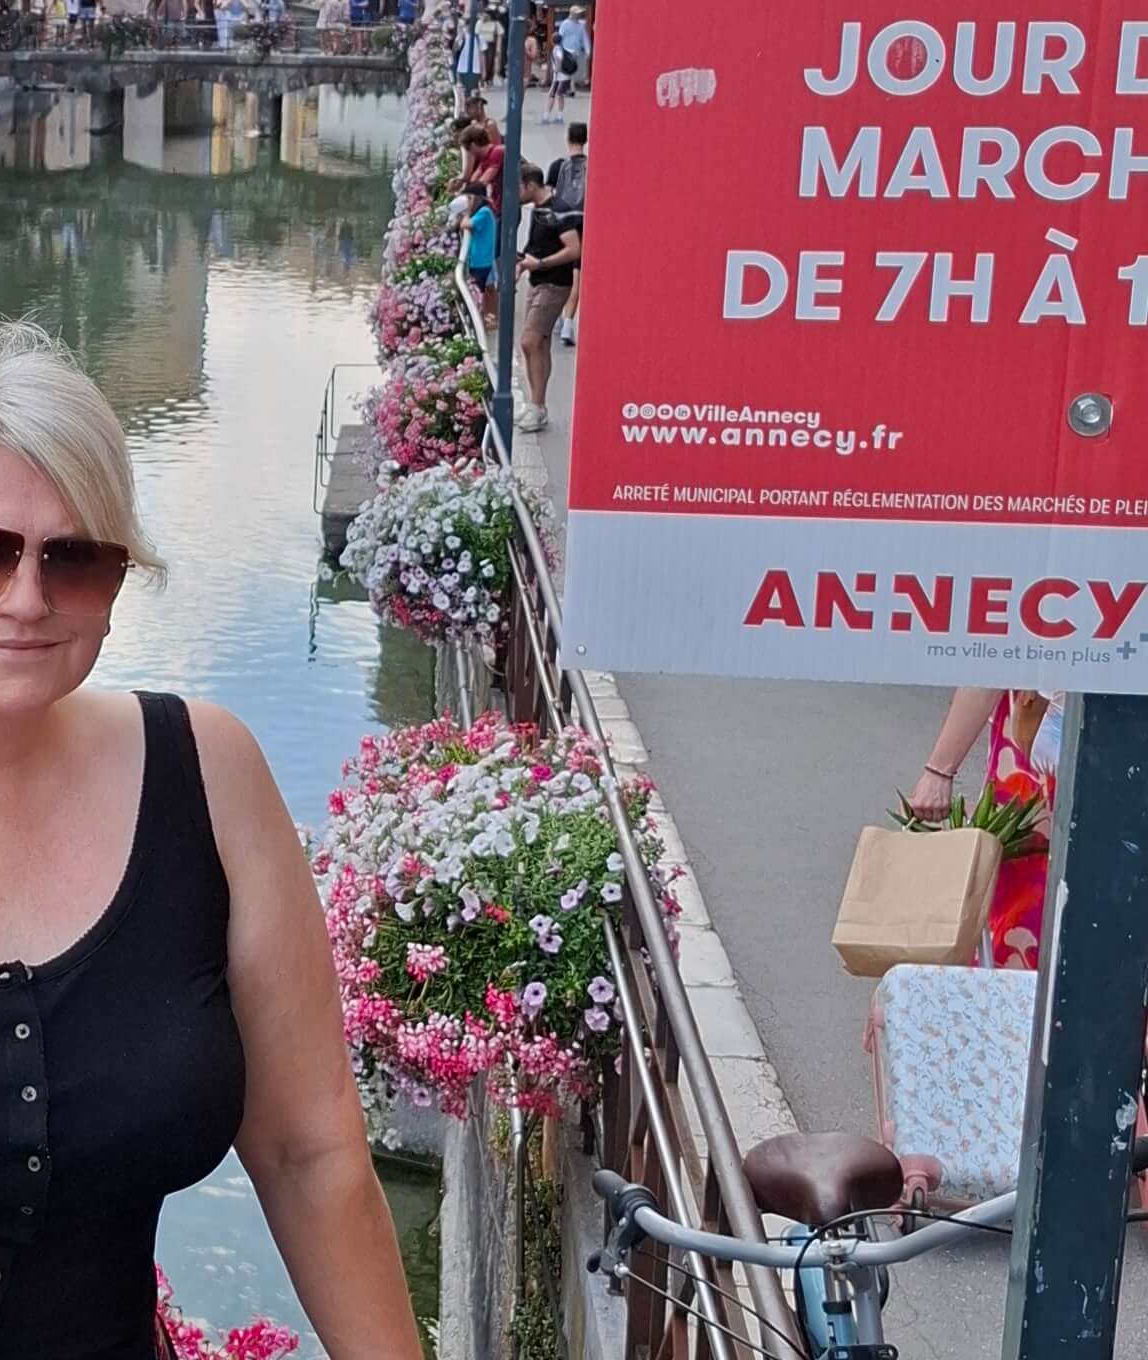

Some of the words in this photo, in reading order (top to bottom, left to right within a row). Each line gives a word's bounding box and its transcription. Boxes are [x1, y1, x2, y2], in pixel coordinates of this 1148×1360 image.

[803, 20, 1086, 97] JOUR
[722, 248, 846, 322] DE
[874, 250, 996, 324] 7H
[1017, 226, 1087, 326] À
[693, 403, 821, 428] VilleAnnecy
[621, 424, 904, 456] www.annecy.fr
[612, 483, 670, 503] ARRETÉ
[673, 486, 755, 505] MUNICIPAL
[759, 489, 829, 507] PORTANT
[832, 488, 969, 511] RÉGLEMENTATION
[972, 495, 1004, 512] DES
[1007, 494, 1085, 514] MARCHÉS
[1089, 497, 1111, 515] DE
[743, 568, 1148, 641] ANNECY
[927, 643, 957, 658] ma
[961, 642, 998, 658] ville
[1003, 644, 1020, 660] et
[1026, 644, 1066, 662] bien
[1071, 647, 1111, 667] plus
